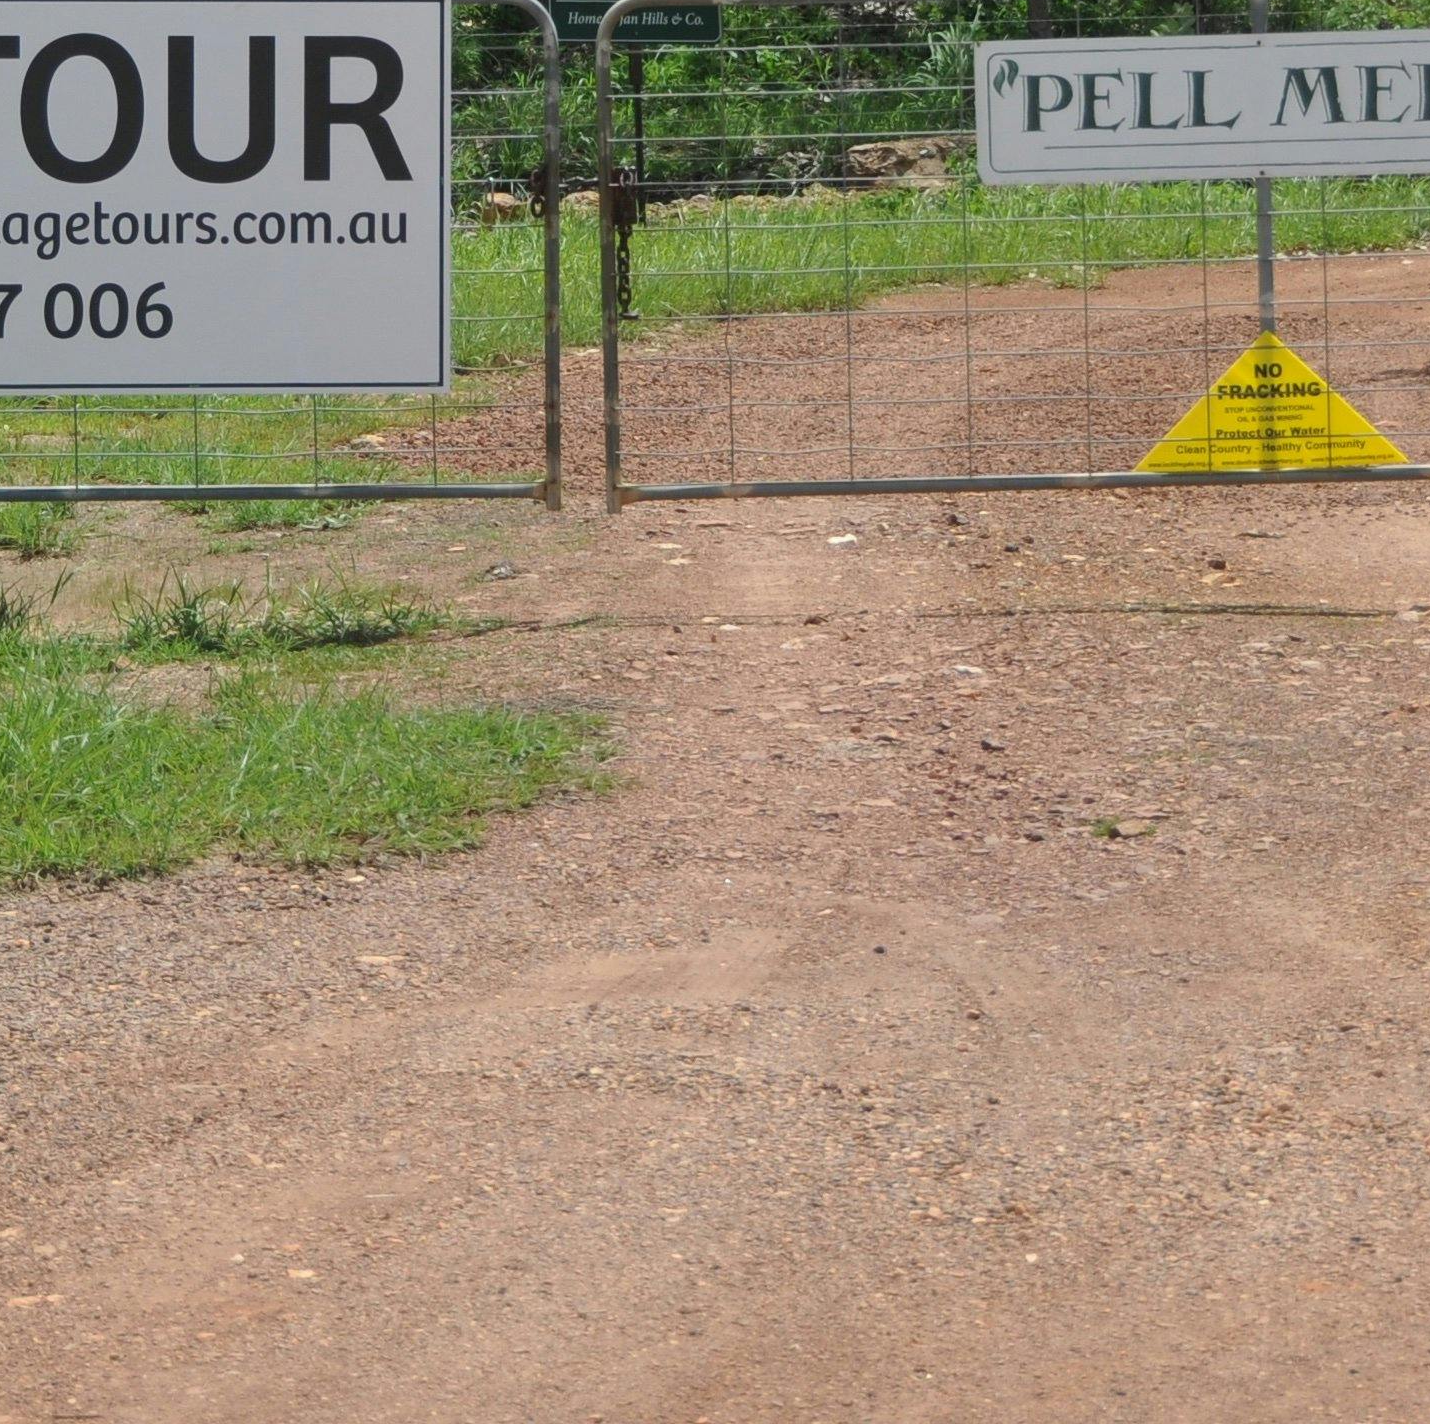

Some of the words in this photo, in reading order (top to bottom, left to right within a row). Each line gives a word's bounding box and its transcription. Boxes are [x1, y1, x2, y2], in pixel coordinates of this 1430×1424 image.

[642, 12, 669, 25] Hills
[672, 13, 682, 26] &
[685, 12, 704, 26] Co.
[1020, 69, 1242, 132] PELL
[43, 281, 174, 340] 006
[1254, 363, 1283, 378] NO
[1217, 382, 1321, 399] FRACKING
[1216, 428, 1261, 439] Protect
[1264, 428, 1286, 438] Our
[1290, 426, 1326, 436] Water
[1175, 445, 1206, 454] Clean
[1209, 444, 1252, 454] Country
[1262, 442, 1302, 453] Healthy
[1304, 439, 1366, 450] Community
